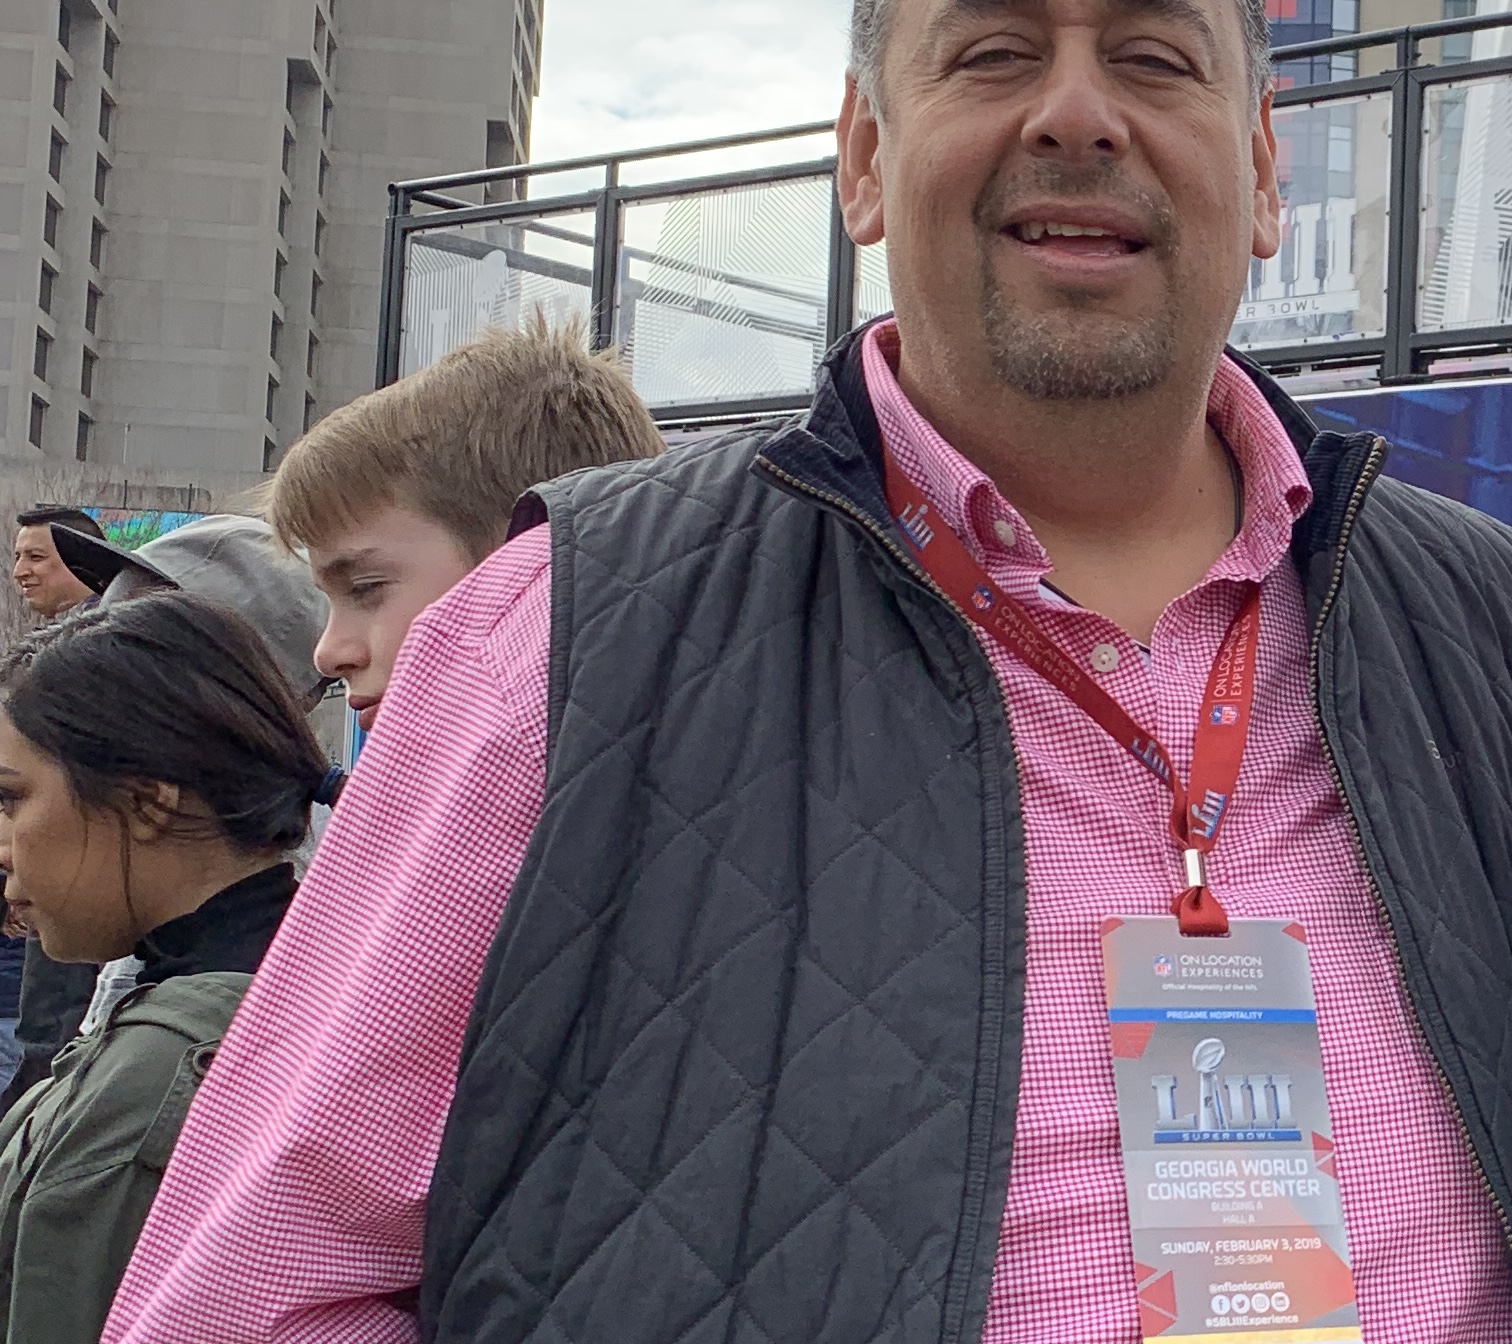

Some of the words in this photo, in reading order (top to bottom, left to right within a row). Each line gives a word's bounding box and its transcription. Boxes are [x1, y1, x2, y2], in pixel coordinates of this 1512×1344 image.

[1230, 614, 1252, 696] EXPERIENCES
[1181, 967, 1264, 979] EXPERIENCES
[1166, 1010, 1208, 1020] PREGAME
[1209, 1010, 1263, 1020] HOSPITALITY
[1151, 1074, 1297, 1130] LIII
[1182, 1133, 1231, 1142] SUPER
[1236, 1132, 1276, 1141] BOWL
[1155, 1159, 1238, 1179] GEORGIA
[1240, 1158, 1308, 1177] WORLD
[1147, 1180, 1246, 1201] CONGRESS
[1249, 1178, 1321, 1198] CENTER
[1160, 1241, 1214, 1255] SUNDAY,
[1215, 1238, 1279, 1252] FEBRUARY
[1280, 1238, 1293, 1252] 3,
[1293, 1237, 1322, 1250] 2019
